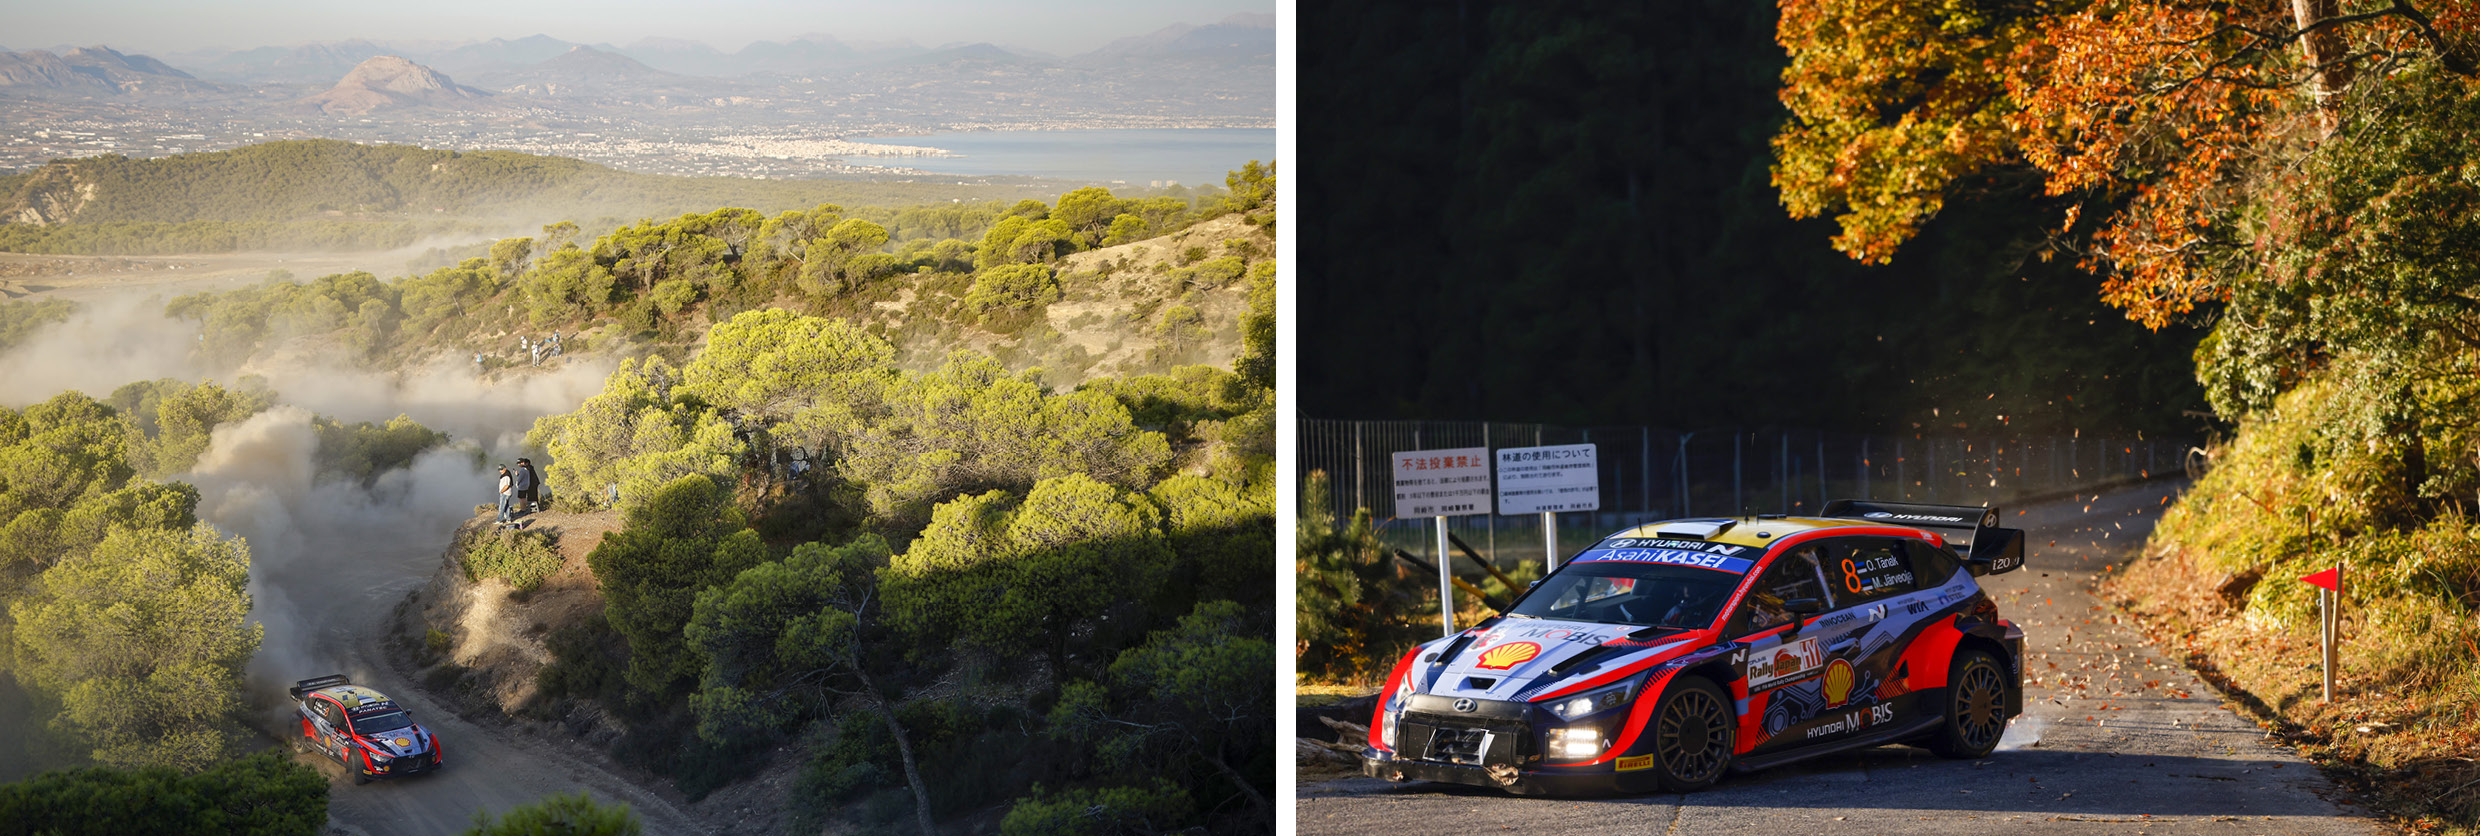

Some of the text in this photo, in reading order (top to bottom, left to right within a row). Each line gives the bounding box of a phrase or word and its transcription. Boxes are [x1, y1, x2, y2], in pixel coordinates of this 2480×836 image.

[1402, 454, 1482, 471] 不法投棄禁止
[1502, 448, 1590, 463] 林道の使用について
[1893, 514, 1964, 523] HYUNDAI
[1637, 539, 1706, 550] HYUNDAI
[1866, 555, 1899, 572] O. Tänak
[1841, 558, 1861, 593] 8
[1872, 577, 1883, 588] M.
[1721, 565, 1763, 621] motorsport.hyundai.com
[1907, 600, 1930, 615] WIA
[1818, 612, 1856, 628] INNOCEAN
[1520, 628, 1609, 646] MOBIS
[1749, 656, 1802, 680] Rally Japan
[1807, 702, 1893, 739] HYUNDAI MOBIS
[1618, 756, 1651, 769] PIRELLI
